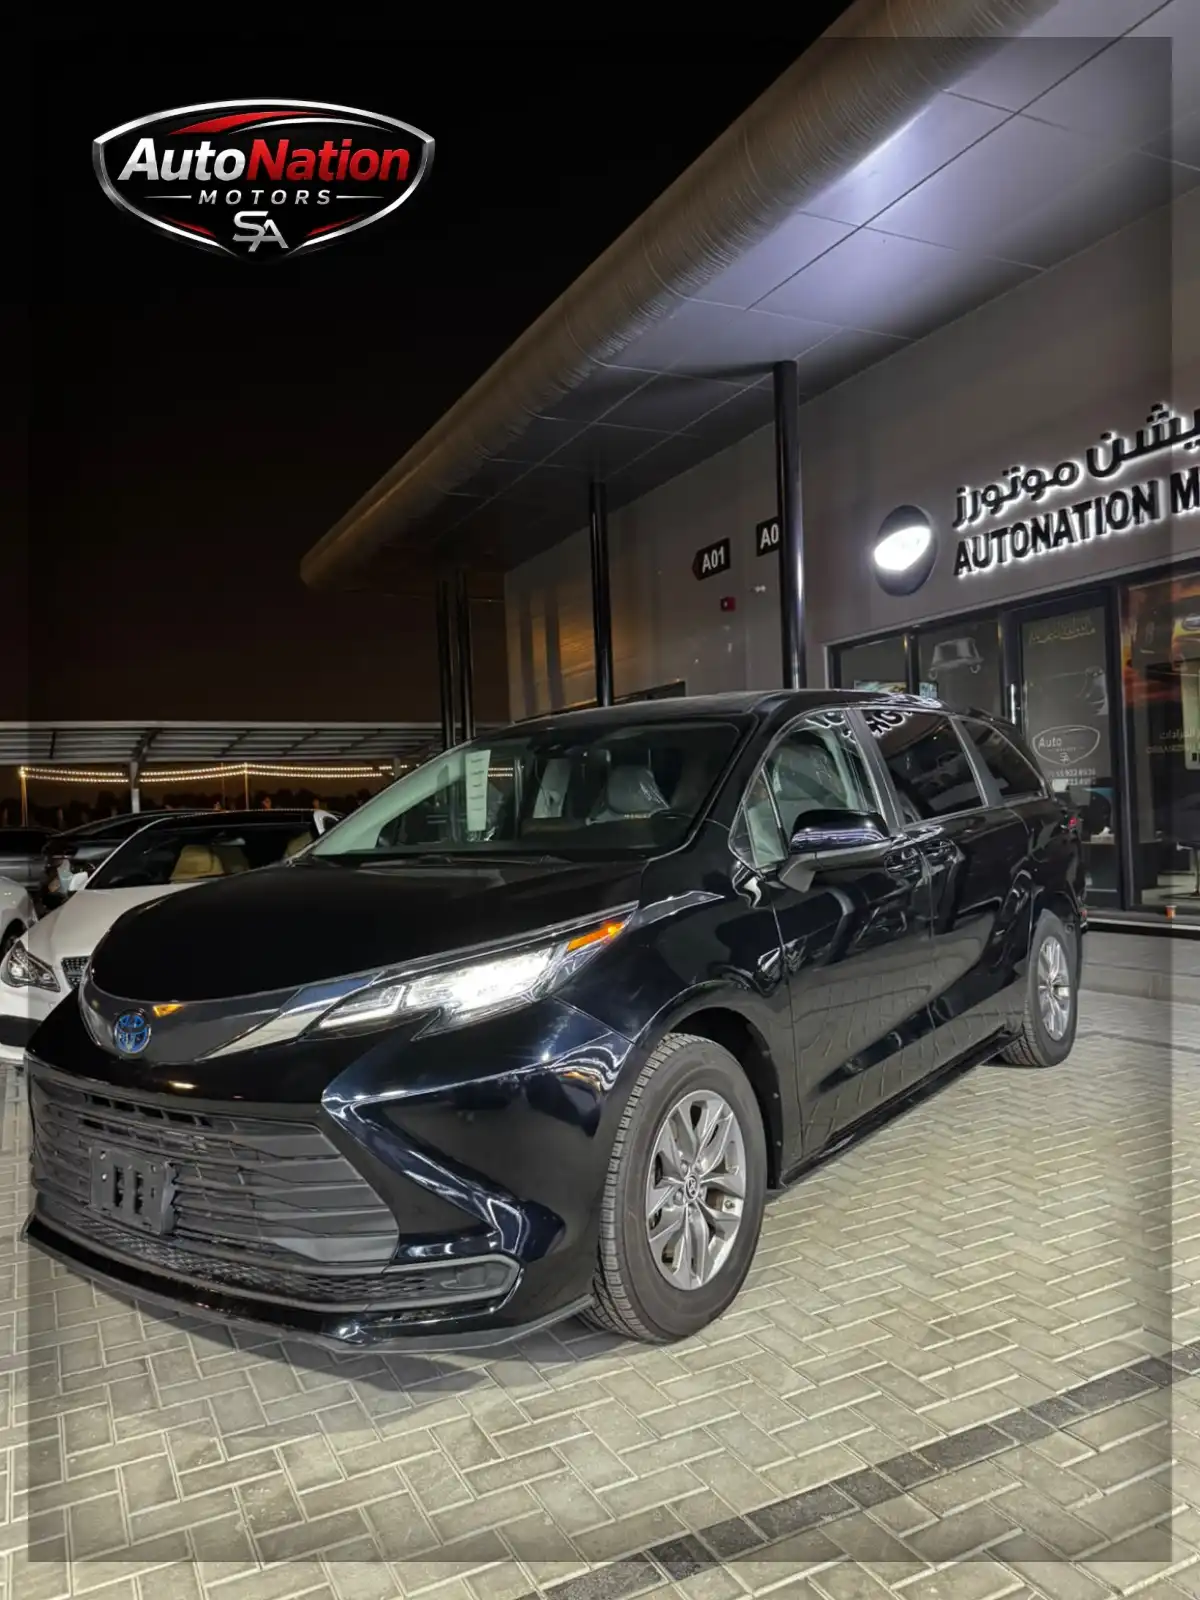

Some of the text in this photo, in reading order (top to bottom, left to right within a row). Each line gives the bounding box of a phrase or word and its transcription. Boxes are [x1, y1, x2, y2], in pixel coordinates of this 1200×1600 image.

[952, 461, 1080, 530] موتورز
[760, 523, 780, 550] A0
[954, 480, 1161, 576] AUTONATION
[702, 546, 725, 573] A01
[1038, 736, 1062, 750] Auto
